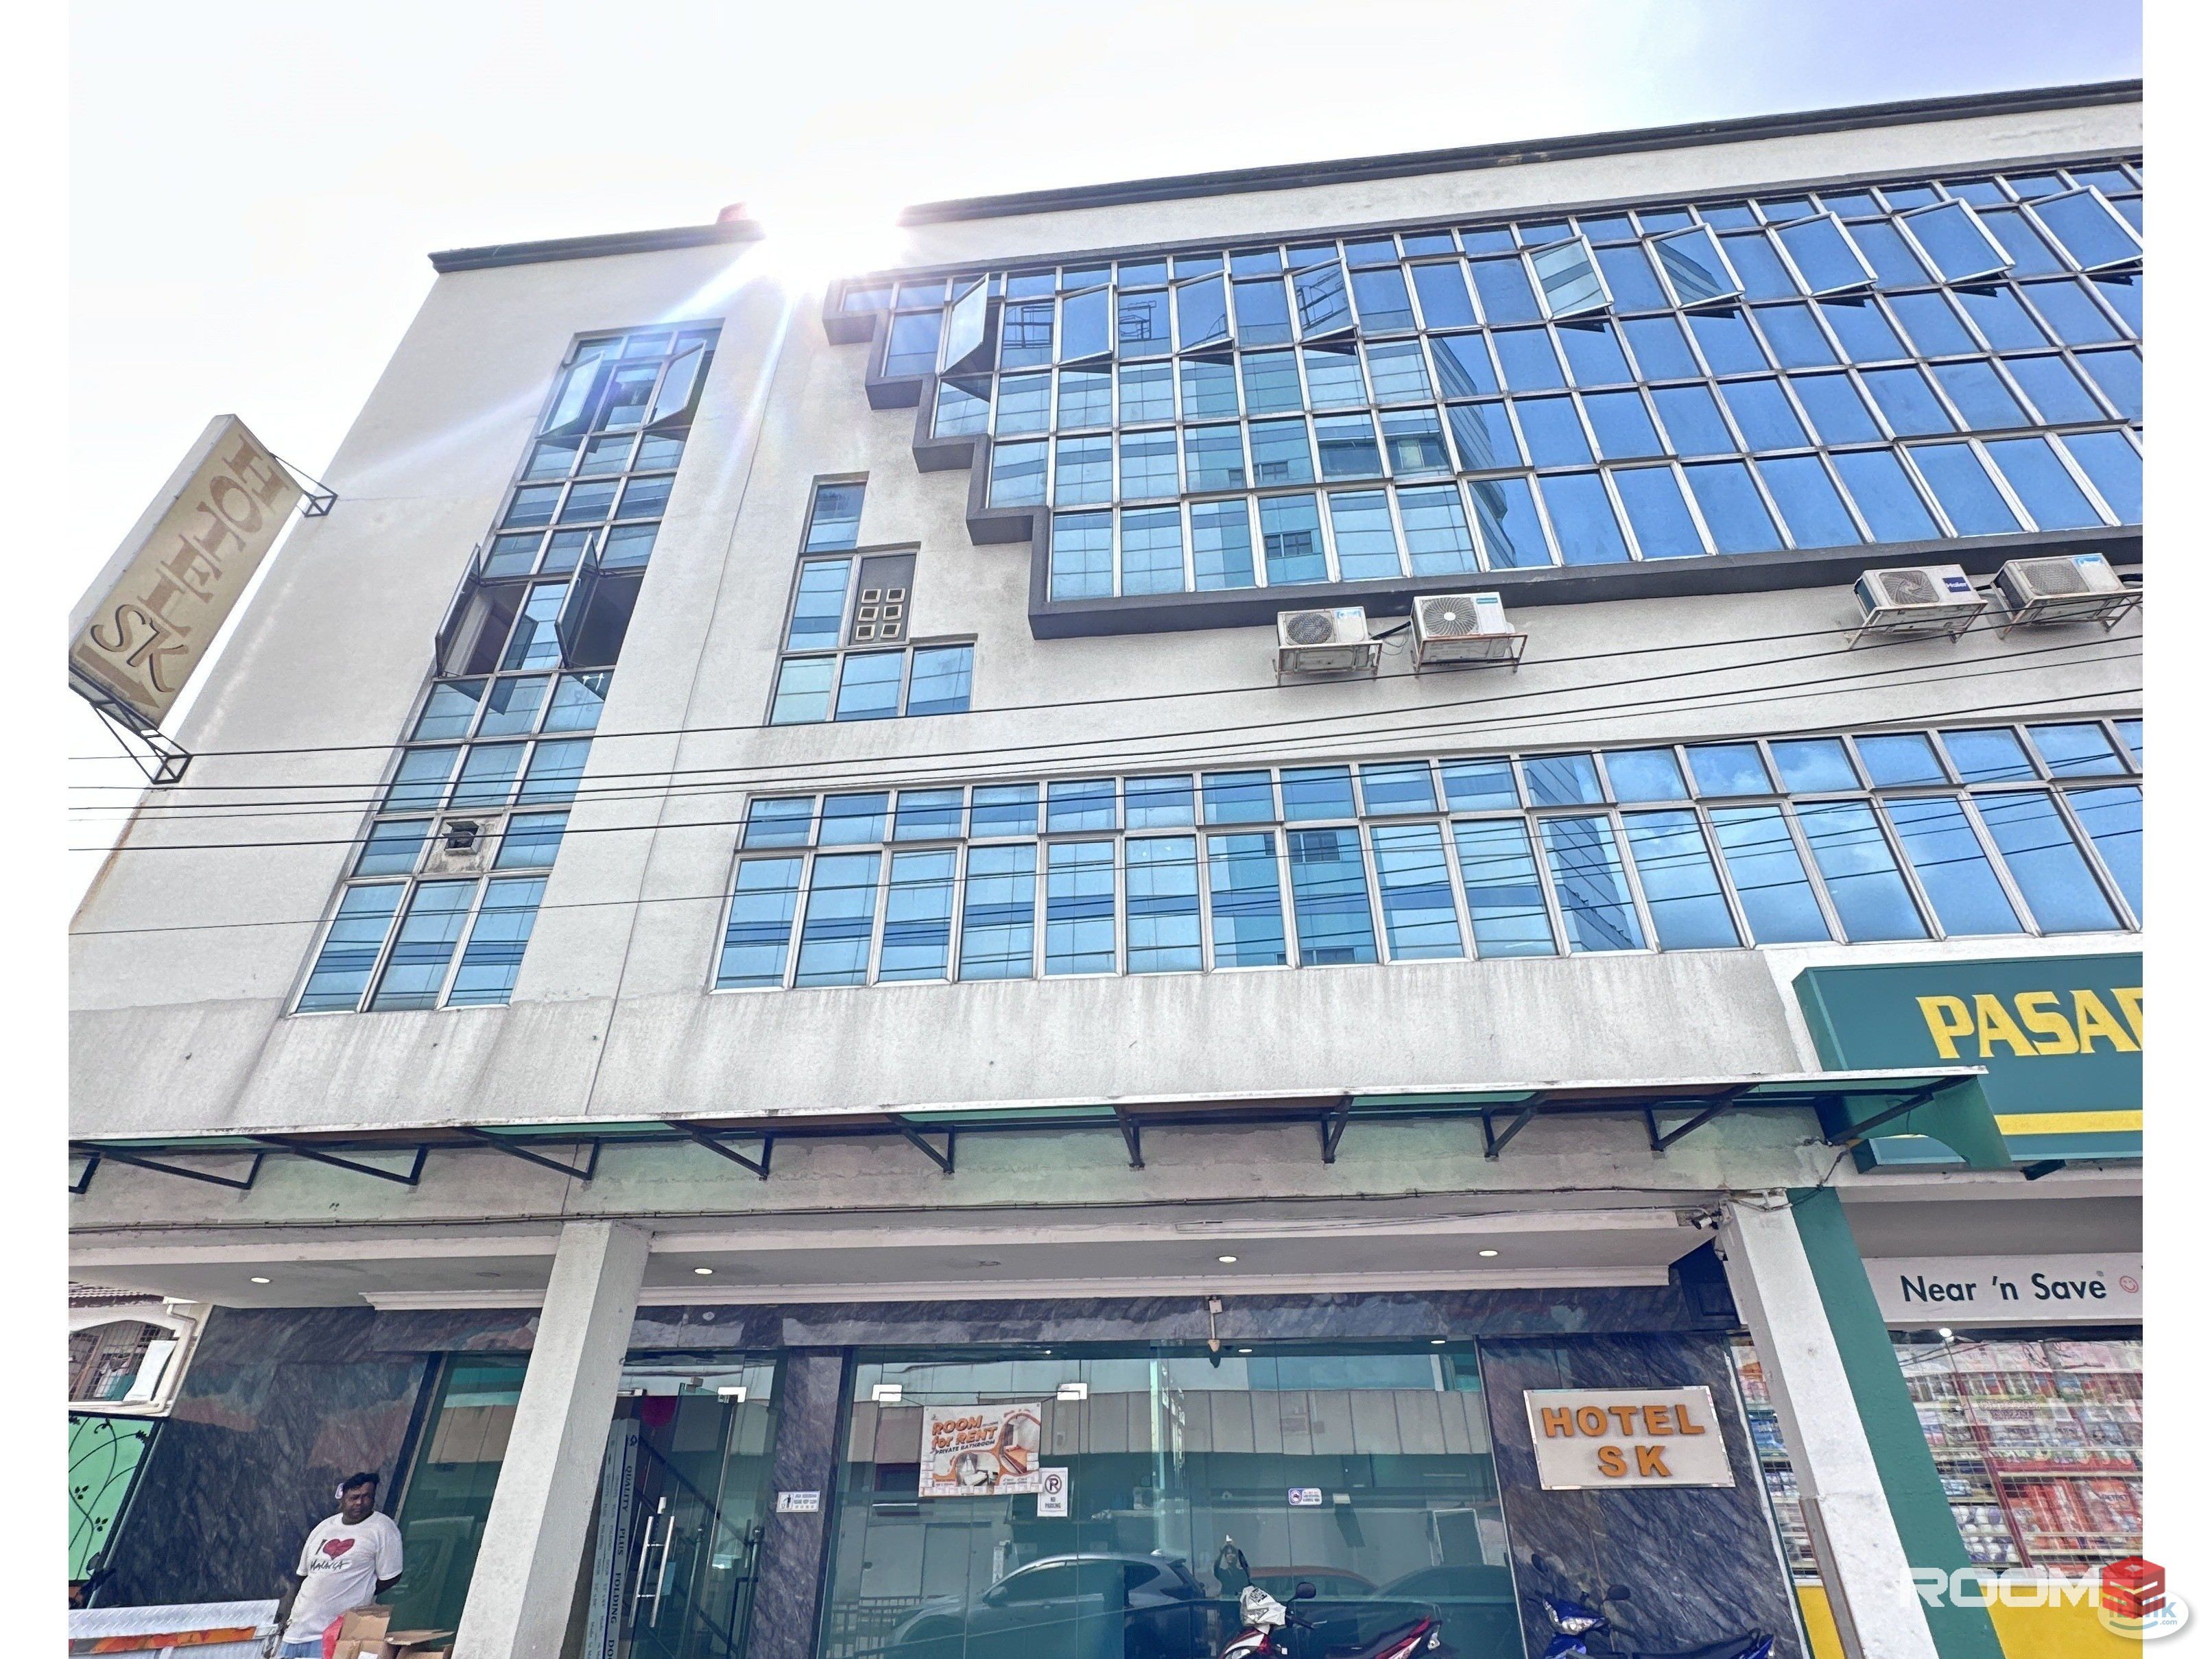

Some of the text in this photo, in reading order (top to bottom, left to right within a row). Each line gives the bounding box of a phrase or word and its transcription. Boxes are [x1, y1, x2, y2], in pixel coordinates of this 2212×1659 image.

[136, 433, 290, 636] HOTEL
[91, 604, 189, 693] SK
[1901, 1275, 1977, 1302] Near
[2032, 1273, 2107, 1300] Save
[931, 1414, 983, 1436] ROOM
[1541, 1404, 1705, 1437] HOTEL
[931, 1427, 998, 1450] for RENT
[934, 1446, 959, 1455] PRIVATE
[1597, 1445, 1673, 1477] SK
[622, 1466, 632, 1512] QUALITY
[617, 1528, 626, 1555] PLUS
[610, 1573, 621, 1624] FOLDING
